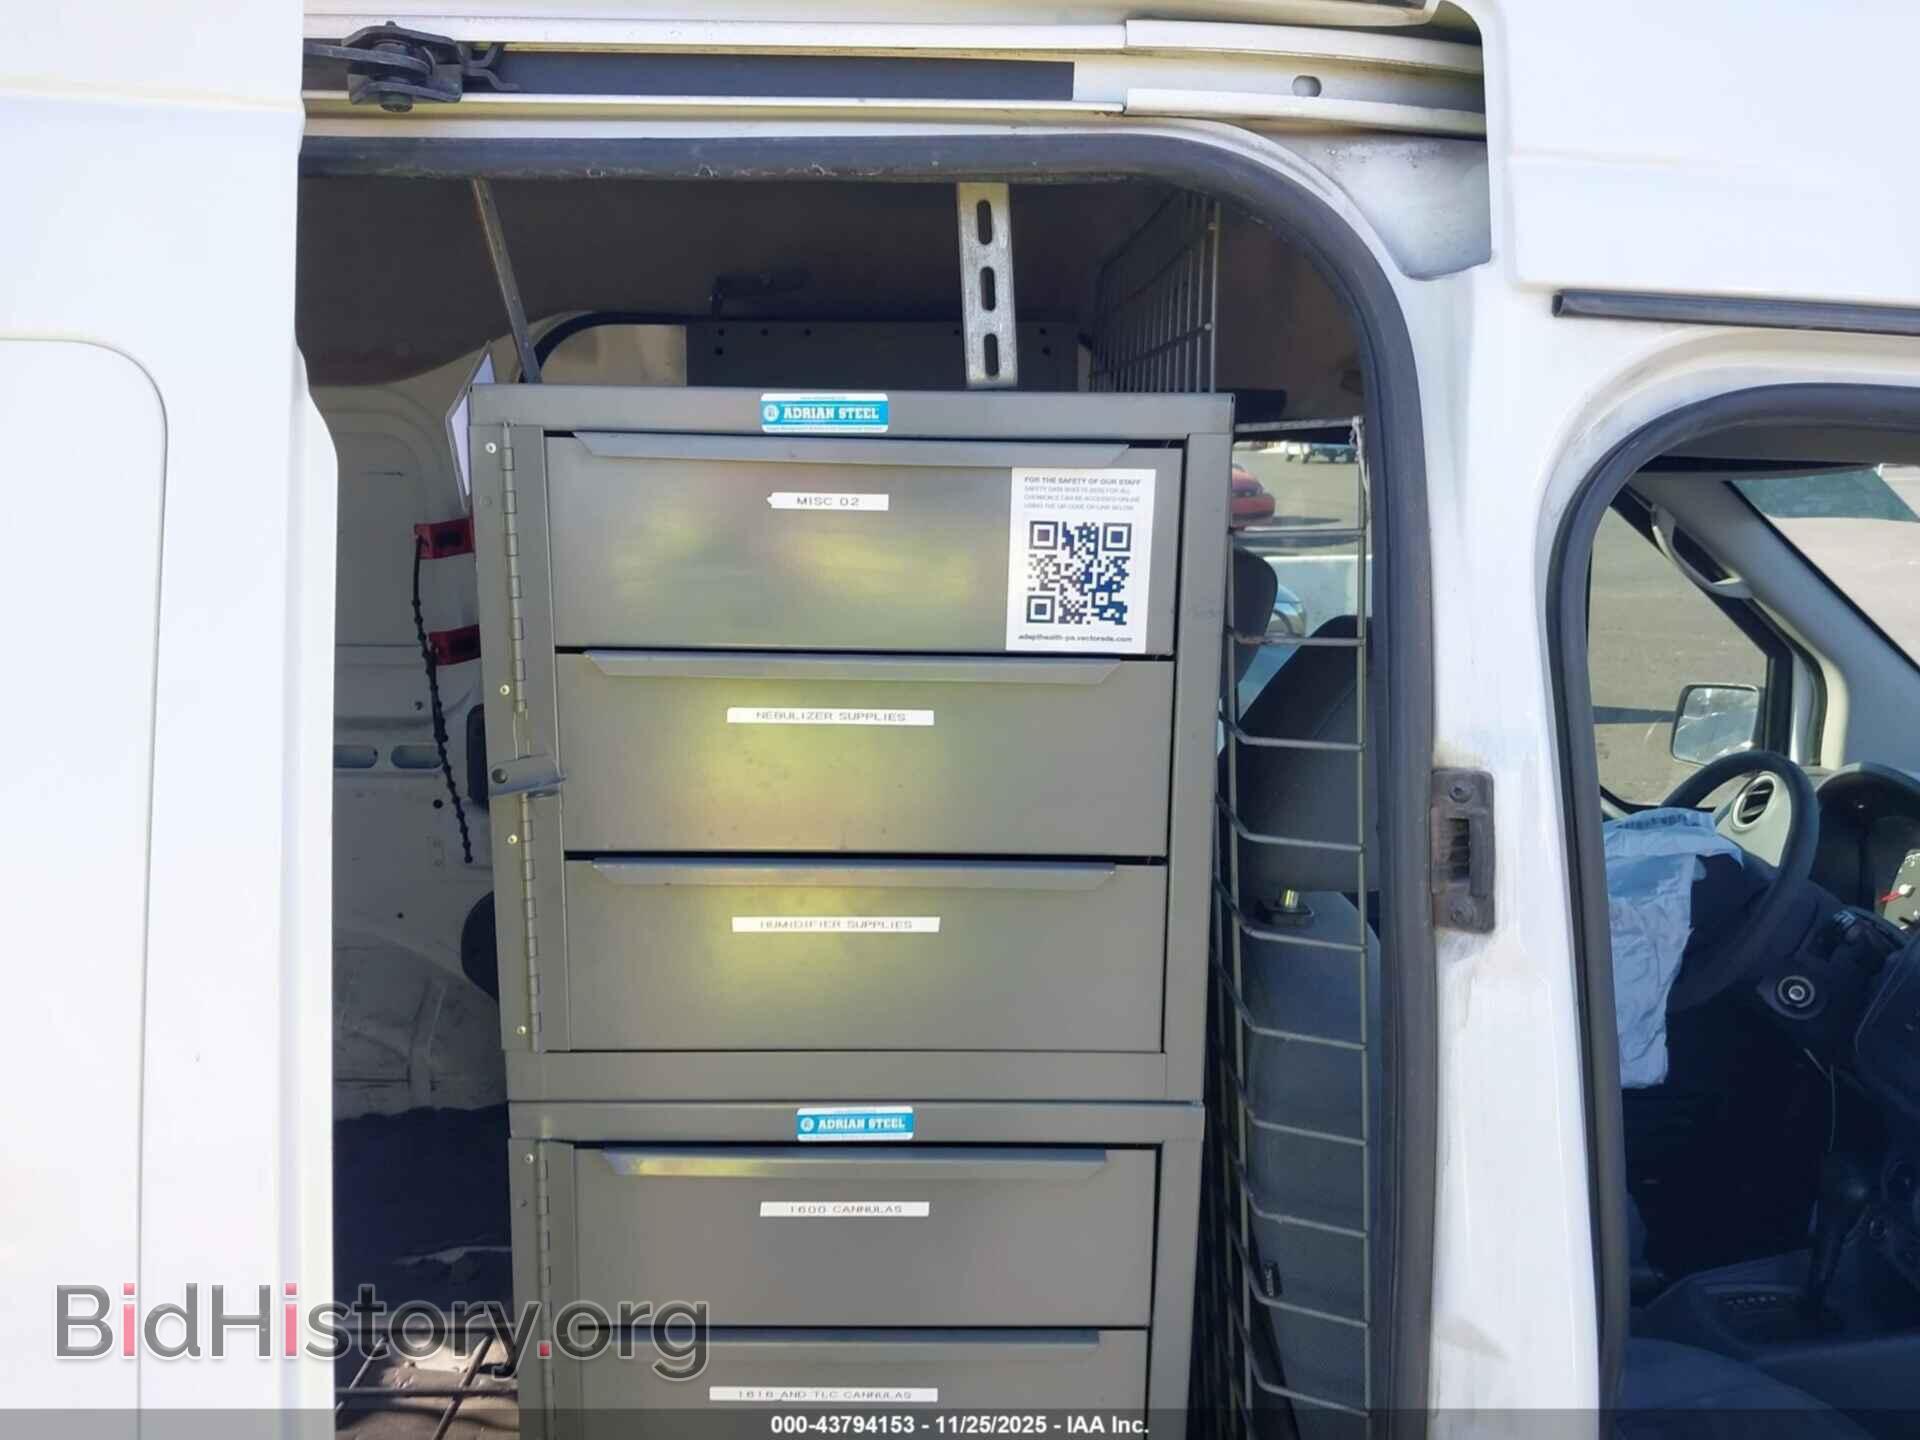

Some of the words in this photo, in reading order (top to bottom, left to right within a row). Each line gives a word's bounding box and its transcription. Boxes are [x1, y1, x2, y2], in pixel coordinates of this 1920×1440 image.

[783, 406, 835, 420] ADRIAN
[838, 406, 880, 420] STEEL
[1024, 476, 1040, 484] FOR
[1042, 476, 1057, 484] THE
[1058, 477, 1087, 485] SAFETY
[1100, 478, 1117, 486] OUR
[796, 496, 833, 507] MISC
[755, 711, 834, 721] NEBULIZER
[838, 712, 907, 722] SUPPLIES
[847, 919, 913, 930] SUPPLIES
[818, 1118, 865, 1130] ADRIAN
[868, 1117, 906, 1129] STEEL
[832, 1205, 904, 1215] CANNULAS
[780, 1390, 807, 1400] AND
[843, 1390, 912, 1400] CANNULAS
